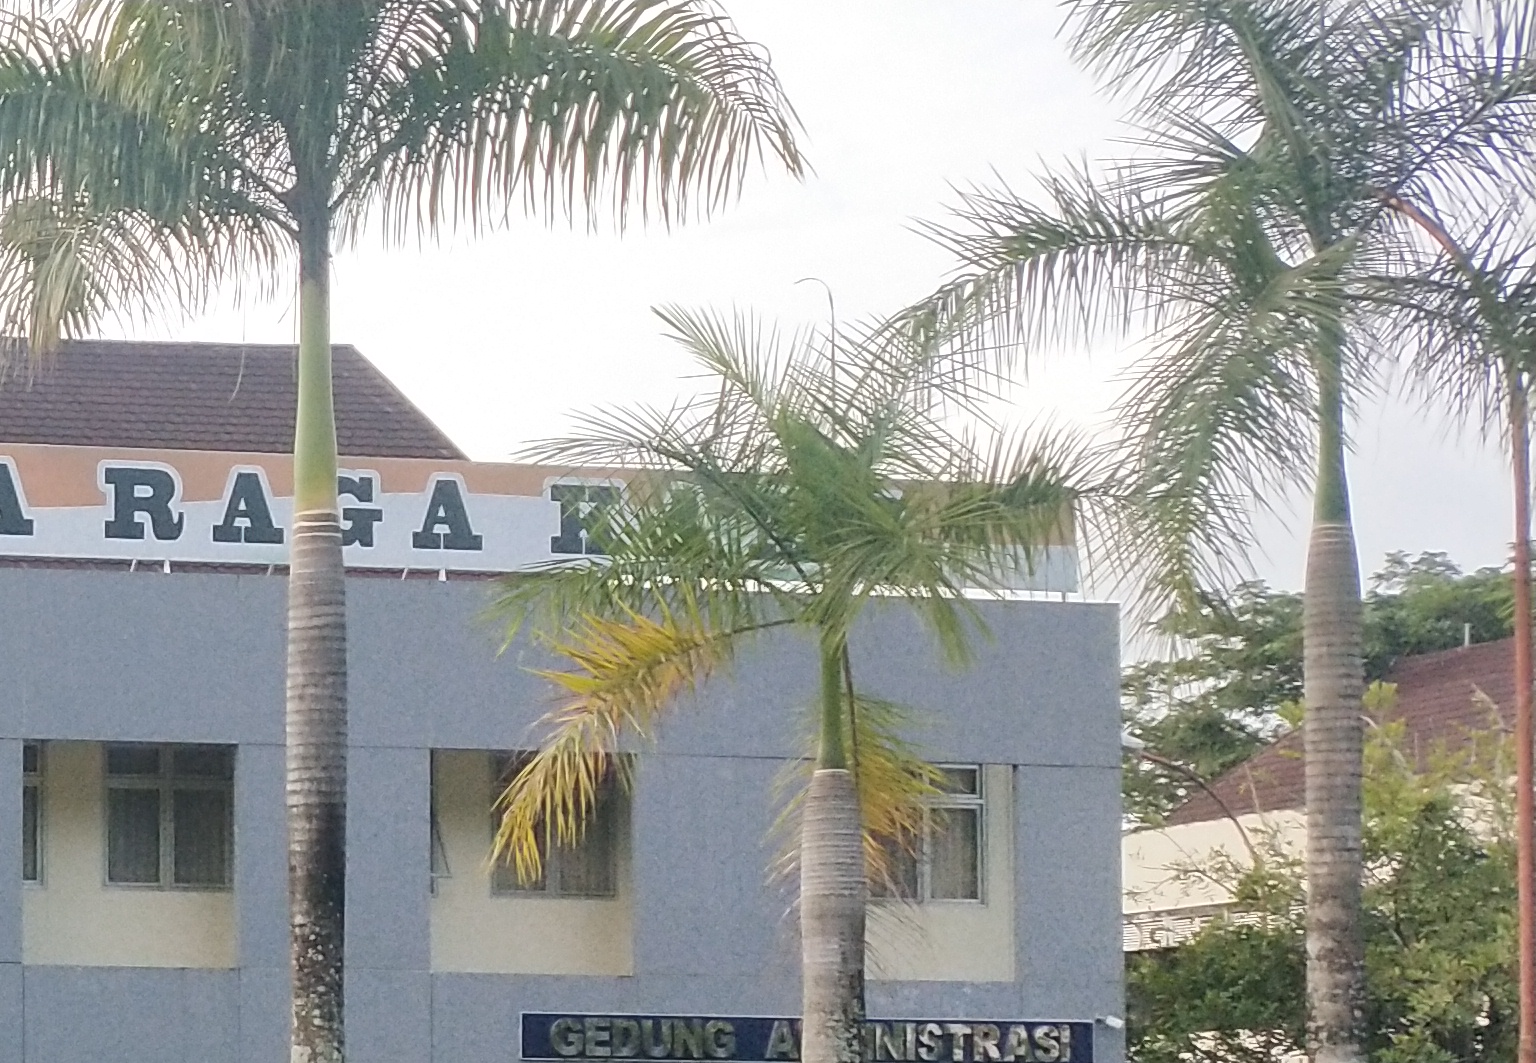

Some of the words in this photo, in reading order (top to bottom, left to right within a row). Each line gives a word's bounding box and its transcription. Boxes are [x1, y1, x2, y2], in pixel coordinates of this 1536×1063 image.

[103, 467, 483, 551] RAGA
[549, 1017, 736, 1059] GEDUNG
[764, 1019, 1071, 1063] AINISTRASI
